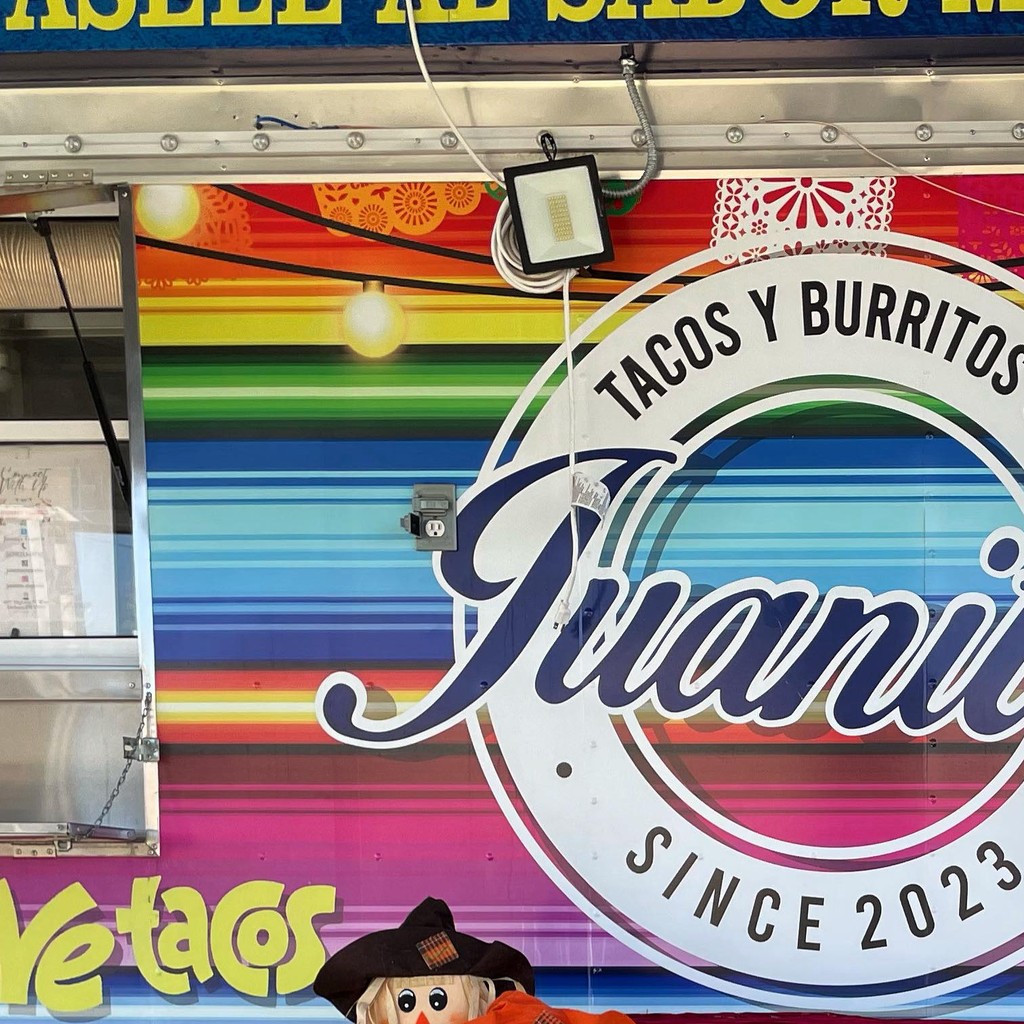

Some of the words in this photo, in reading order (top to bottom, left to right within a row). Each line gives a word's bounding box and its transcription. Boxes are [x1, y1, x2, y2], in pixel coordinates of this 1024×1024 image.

[593, 302, 742, 421] TACOS
[748, 285, 779, 342] Y
[626, 826, 825, 951] SINCE
[855, 840, 1022, 950] 2023
